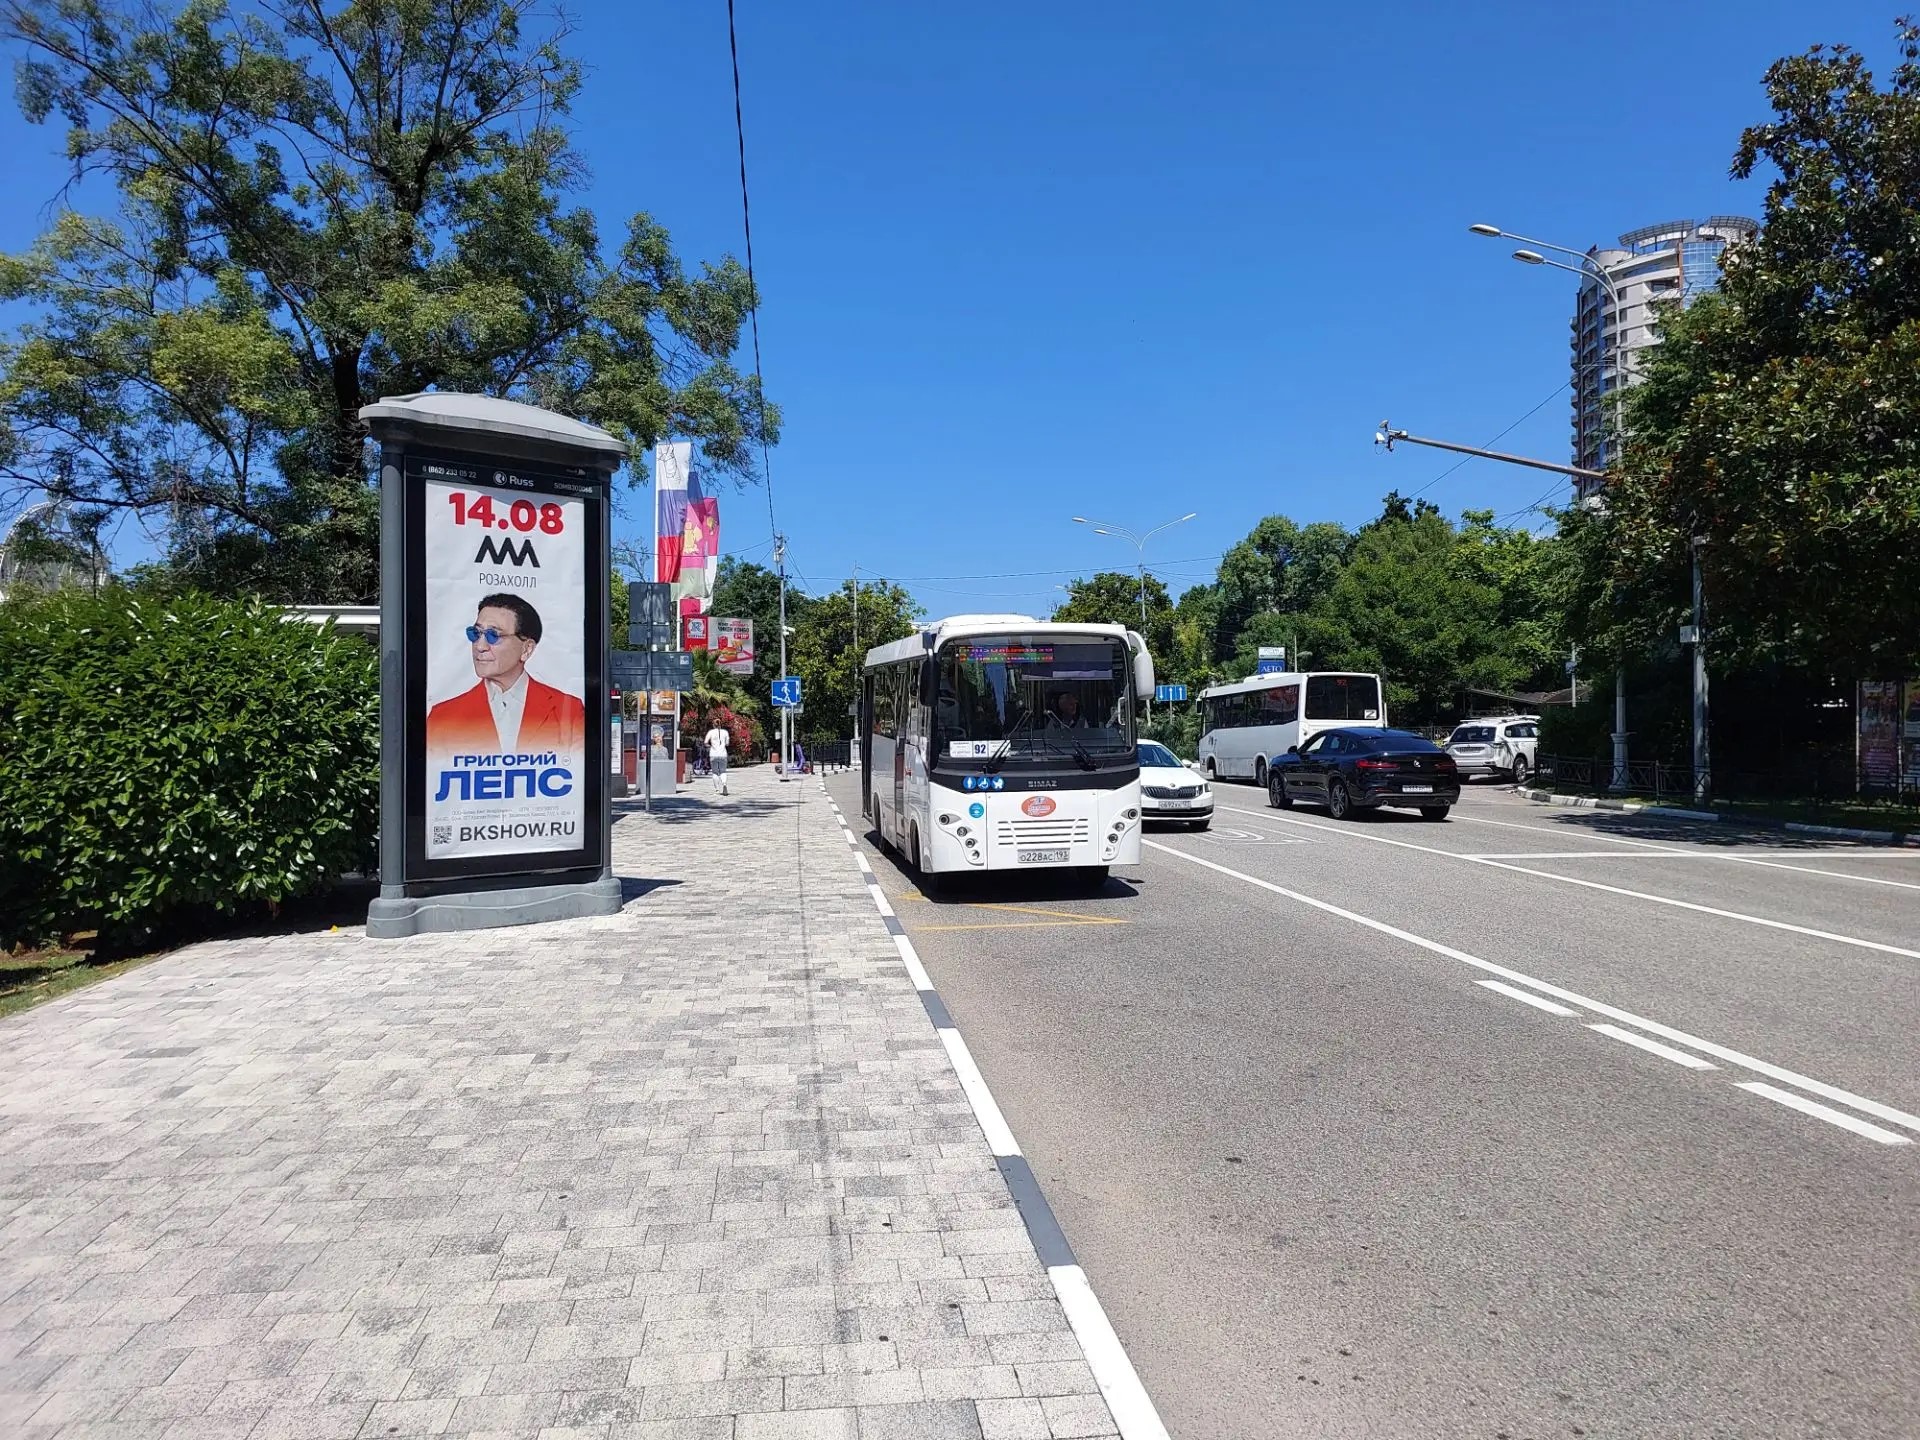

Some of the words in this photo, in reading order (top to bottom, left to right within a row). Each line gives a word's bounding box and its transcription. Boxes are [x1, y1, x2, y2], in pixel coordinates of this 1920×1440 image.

[509, 475, 535, 487] Russ
[449, 492, 564, 535] 14.08
[479, 572, 537, 588] РОЗАХОЛЛ
[974, 743, 987, 755] 92
[453, 751, 557, 767] ГРИГОРИЙ
[435, 768, 573, 802] ЛЕПС
[460, 821, 576, 842] BKSHOW.RU
